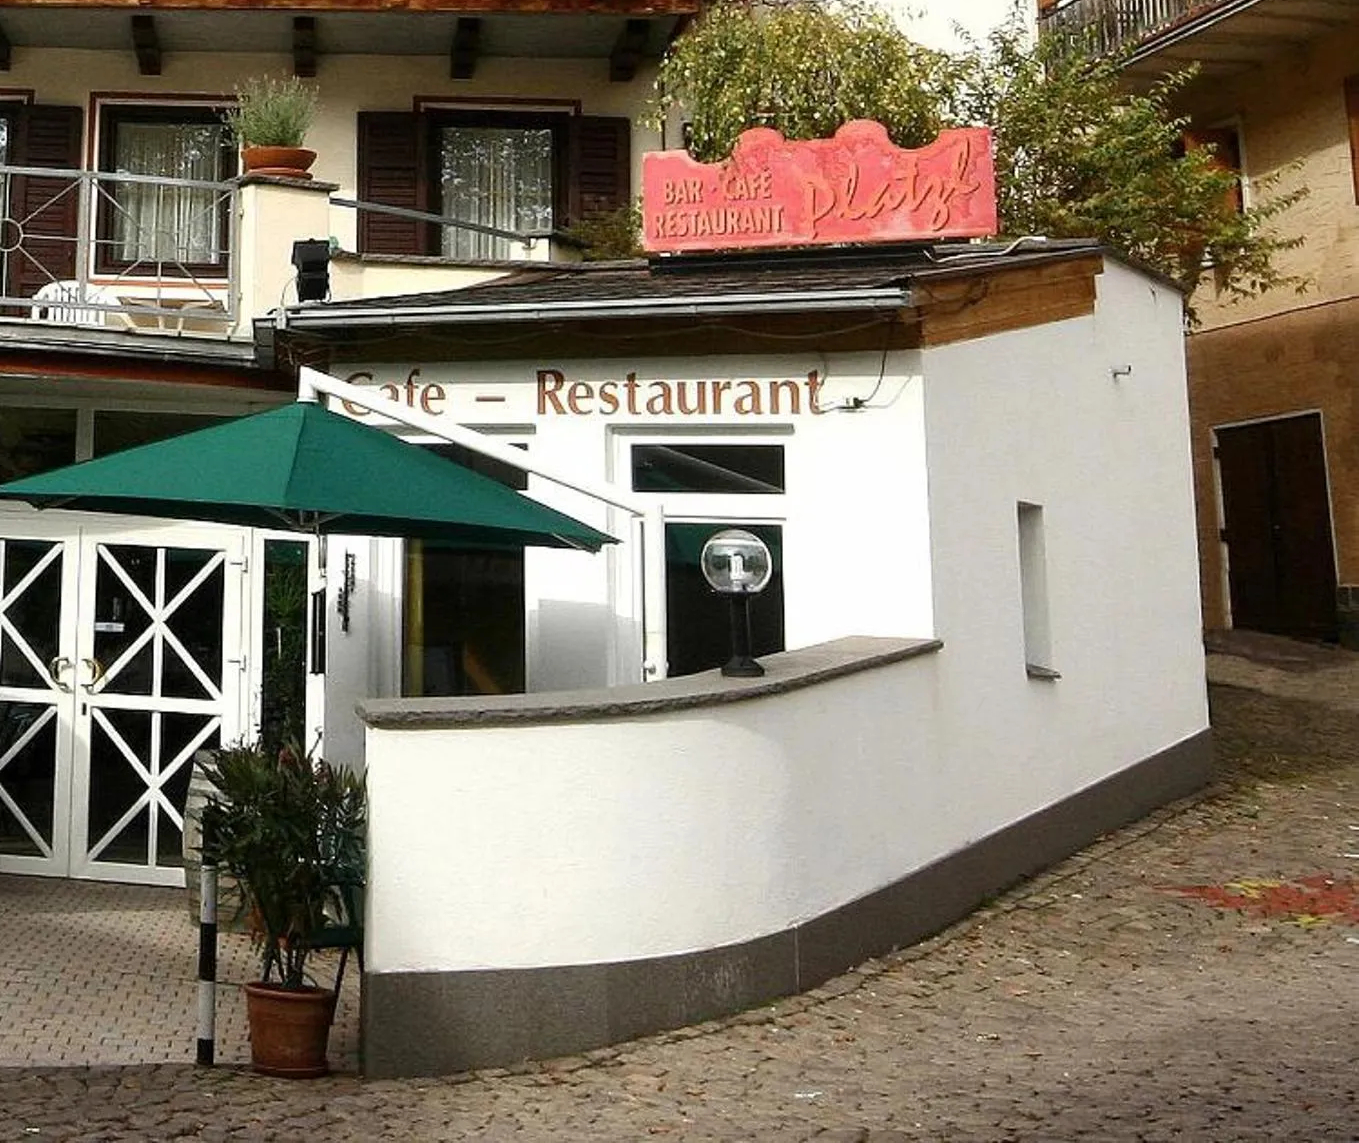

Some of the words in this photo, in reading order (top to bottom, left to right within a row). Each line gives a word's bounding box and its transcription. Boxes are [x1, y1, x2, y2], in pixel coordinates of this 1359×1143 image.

[664, 178, 704, 205] BAR
[654, 206, 785, 238] RESTAURANT
[537, 370, 826, 416] Restaurant
